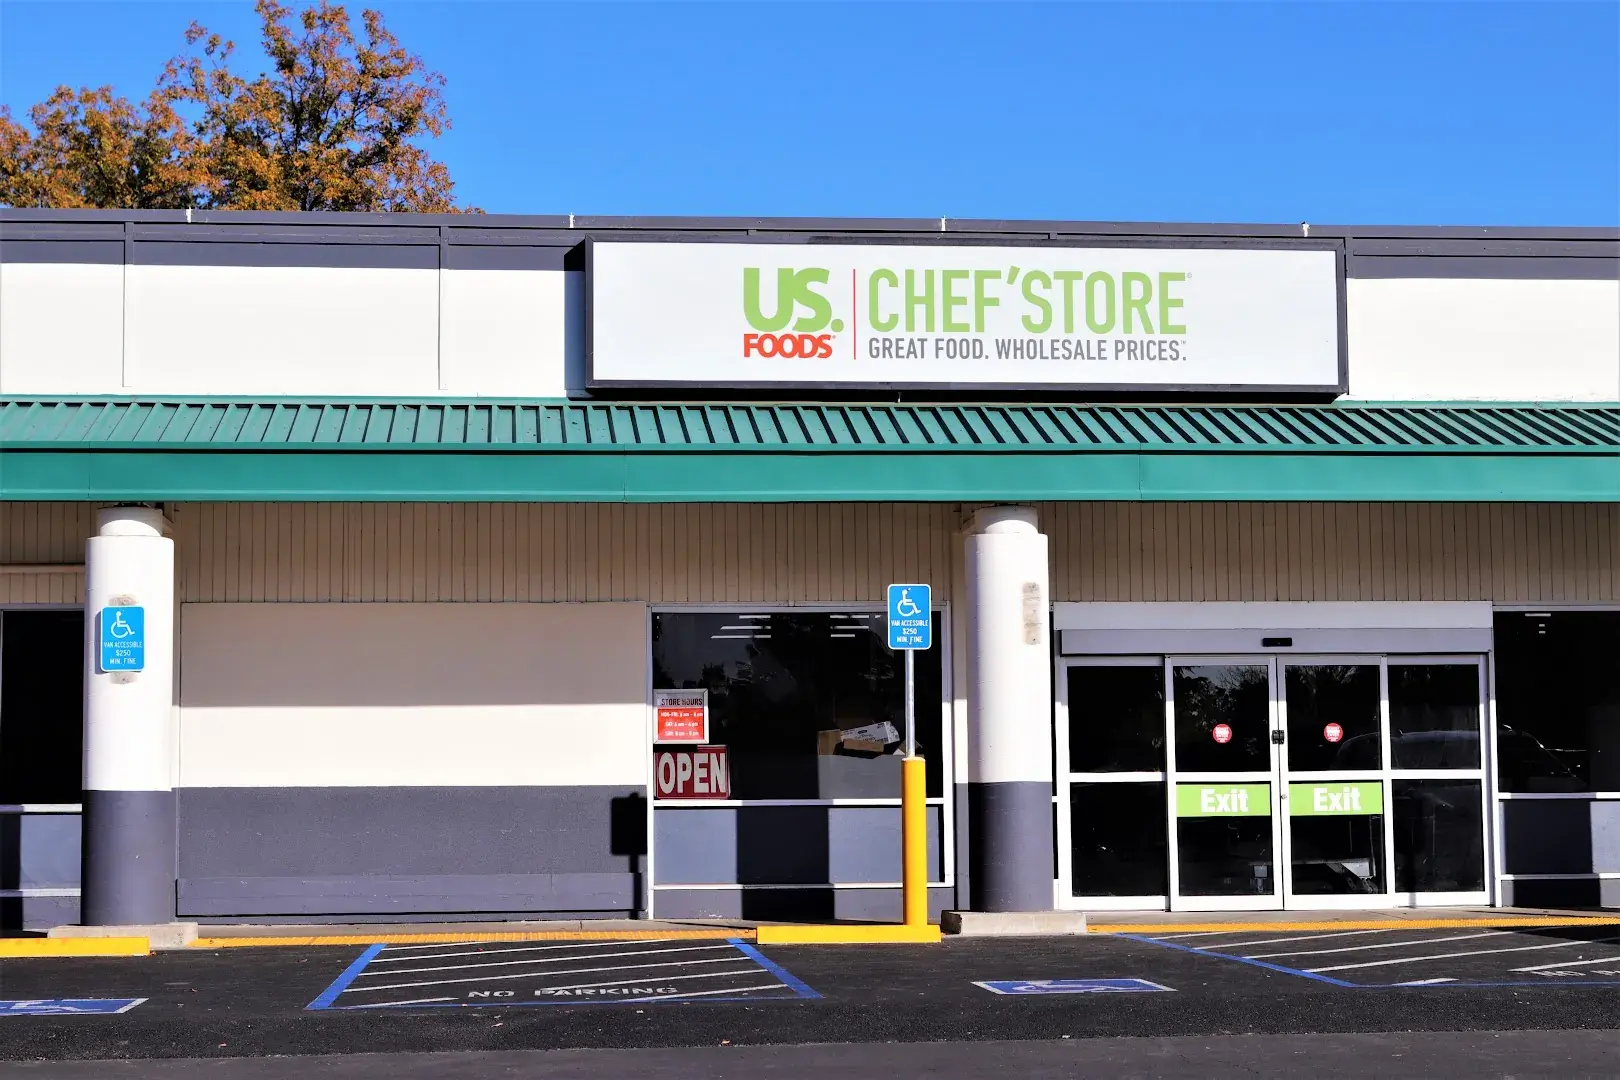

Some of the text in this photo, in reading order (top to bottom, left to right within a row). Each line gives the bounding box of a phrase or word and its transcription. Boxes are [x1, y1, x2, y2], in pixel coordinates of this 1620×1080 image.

[743, 333, 833, 358] FOODS
[868, 337, 1187, 361] GREAT FOOD. WHOLESALE PRICES.
[661, 698, 703, 706] STORE HOURS
[658, 752, 727, 794] OPEN
[1200, 787, 1249, 813] Exit
[1313, 786, 1362, 812] Exit
[467, 987, 678, 998] NO PARKING
